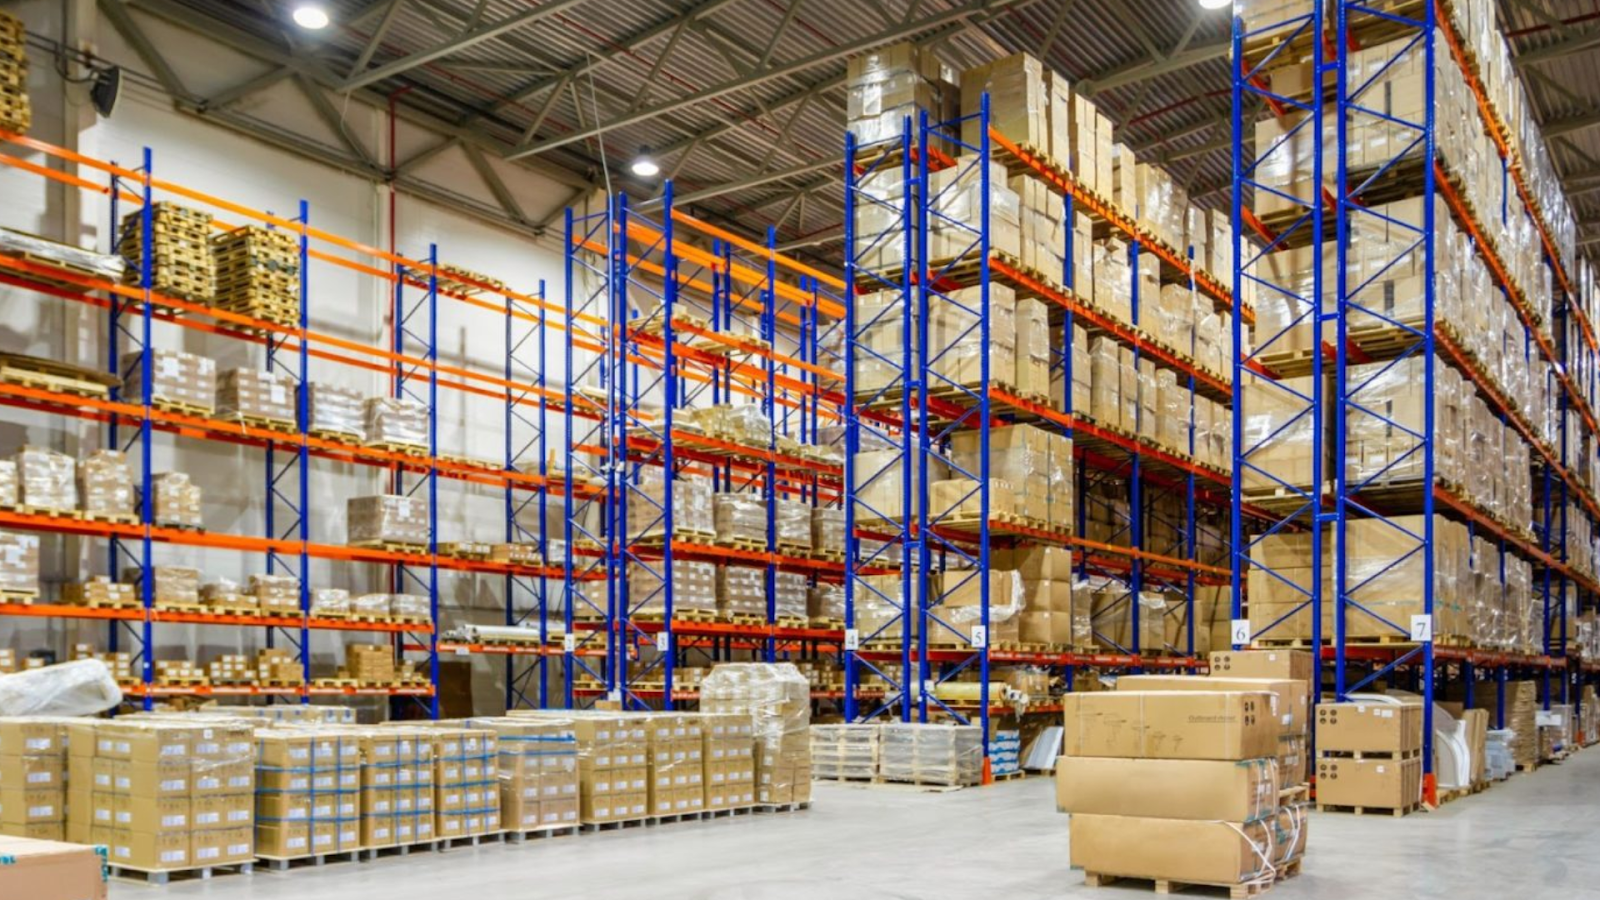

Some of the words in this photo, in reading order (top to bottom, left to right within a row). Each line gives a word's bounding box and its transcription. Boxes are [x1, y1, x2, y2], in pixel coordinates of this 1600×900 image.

[1236, 627, 1246, 641] 6
[1415, 622, 1426, 638] 7
[847, 634, 855, 646] 4
[974, 631, 982, 645] 5
